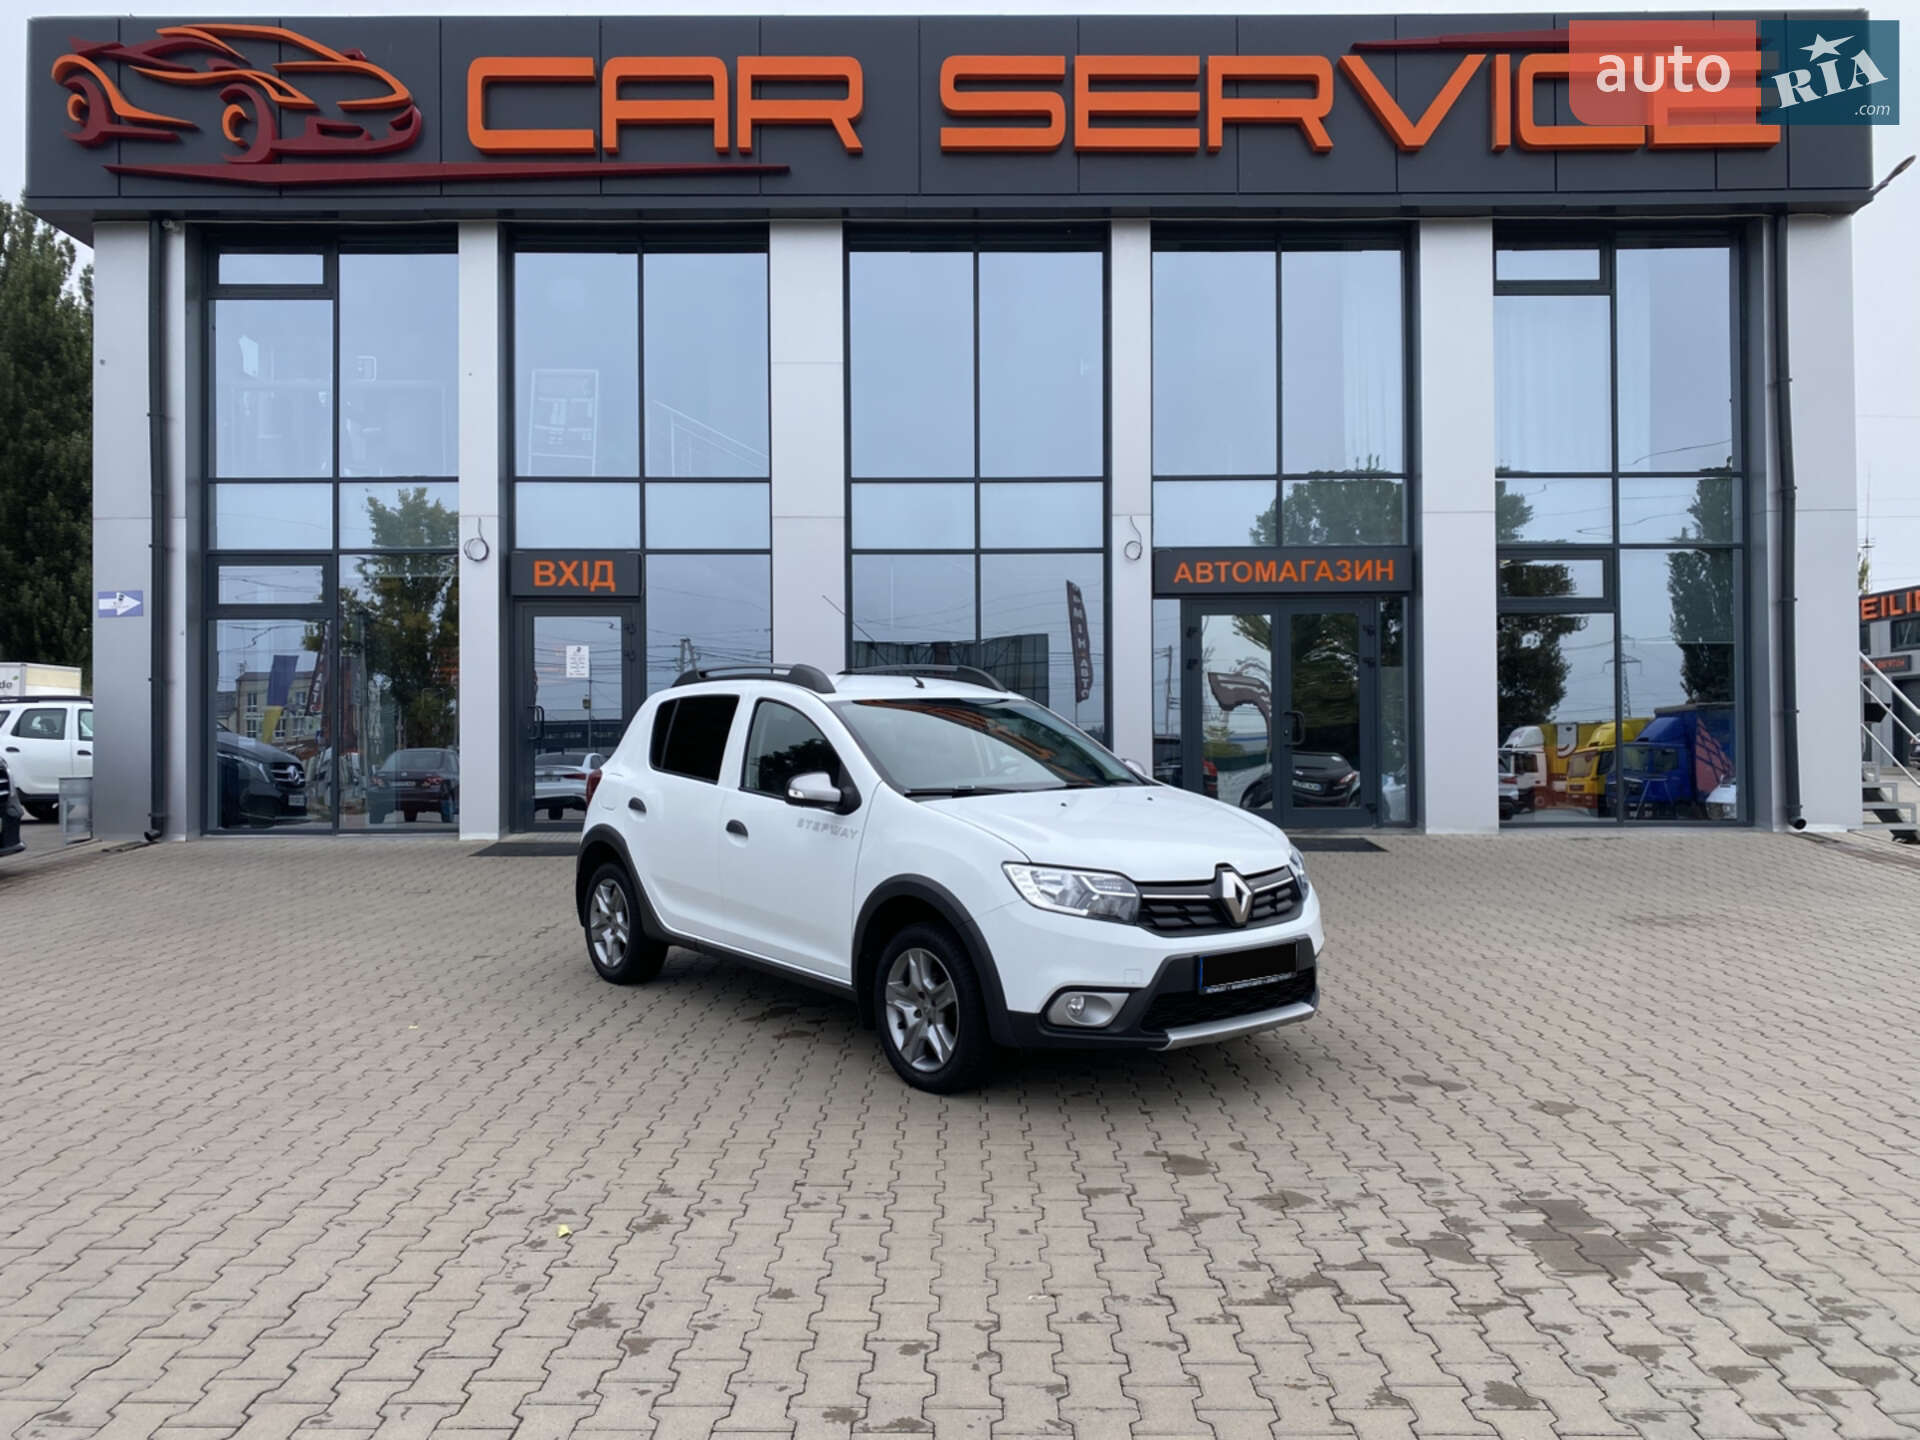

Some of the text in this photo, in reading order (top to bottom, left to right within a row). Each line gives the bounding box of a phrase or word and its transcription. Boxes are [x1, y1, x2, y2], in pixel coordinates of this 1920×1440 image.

[467, 53, 1781, 154] CAR SERVICE
[533, 560, 616, 592] ВХІД
[1173, 559, 1395, 584] АВТОМАГАЗИН
